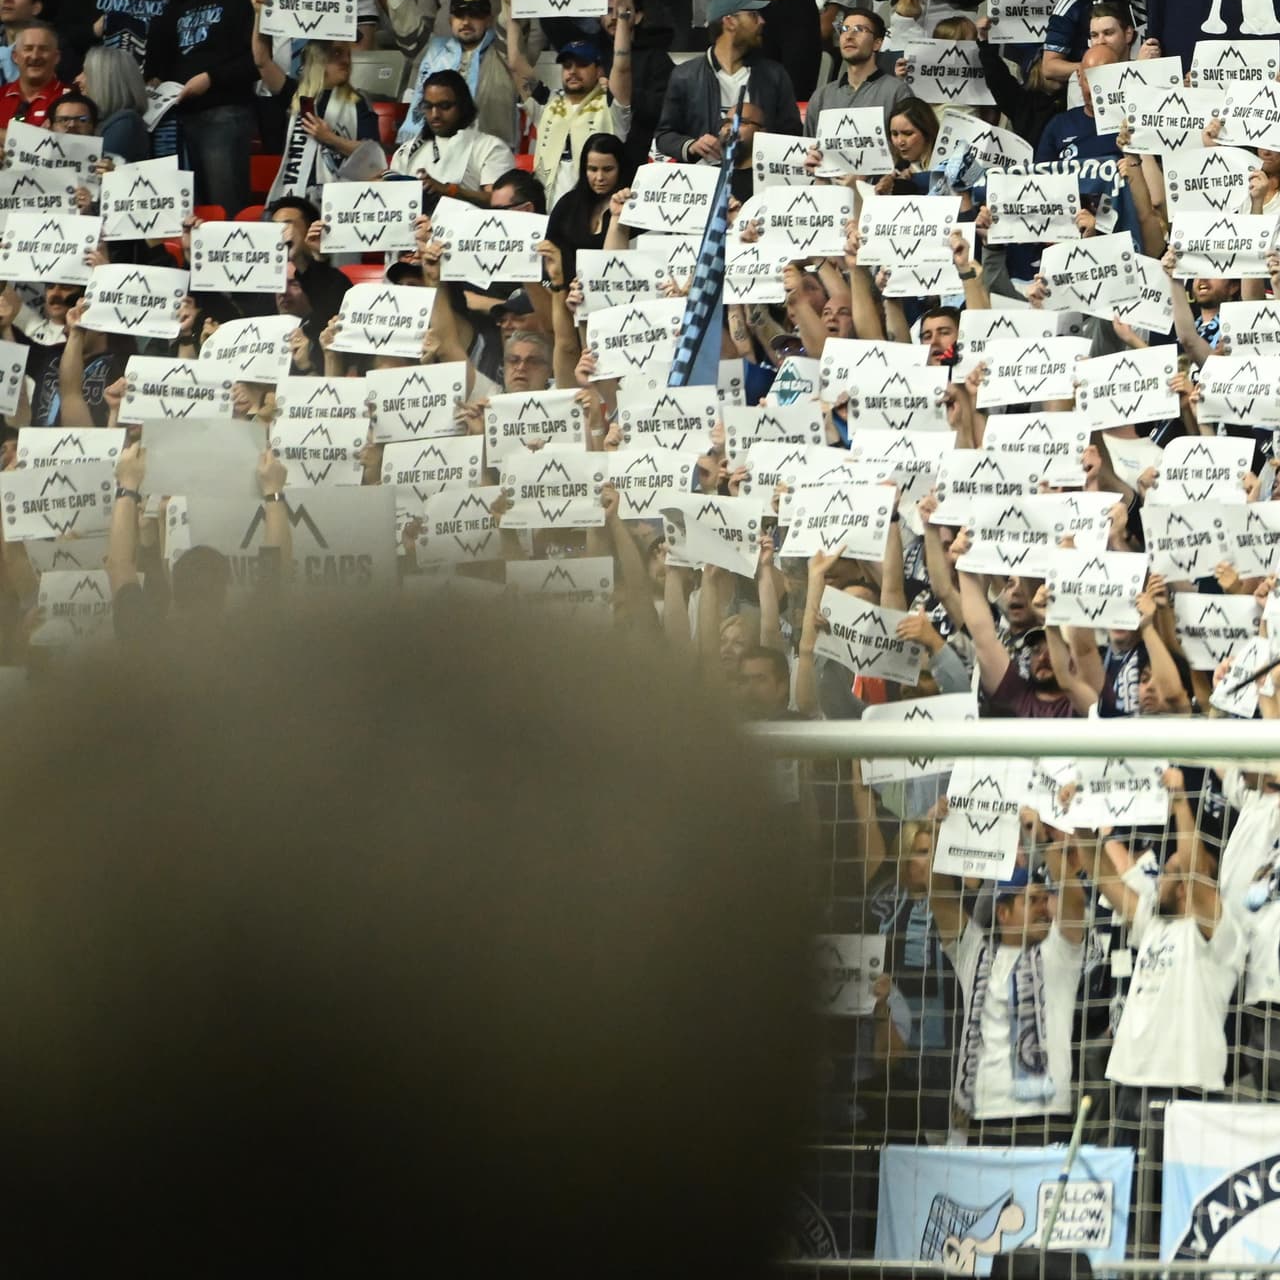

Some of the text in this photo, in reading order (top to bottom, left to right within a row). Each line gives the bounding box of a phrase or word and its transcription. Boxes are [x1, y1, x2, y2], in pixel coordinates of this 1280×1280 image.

[279, 0, 339, 12] SAVE THE CAPS
[338, 211, 402, 223] SAVE THE CAPS
[458, 240, 523, 252] SAVE THE CAPS
[208, 251, 269, 263] SAVE THE CAPS
[143, 384, 214, 400] SAVE THE CAPS
[833, 623, 904, 654] SAVE THE CAPS
[949, 796, 1018, 815] SAVE THE CAPS
[1044, 1190, 1106, 1203] FLLOW,
